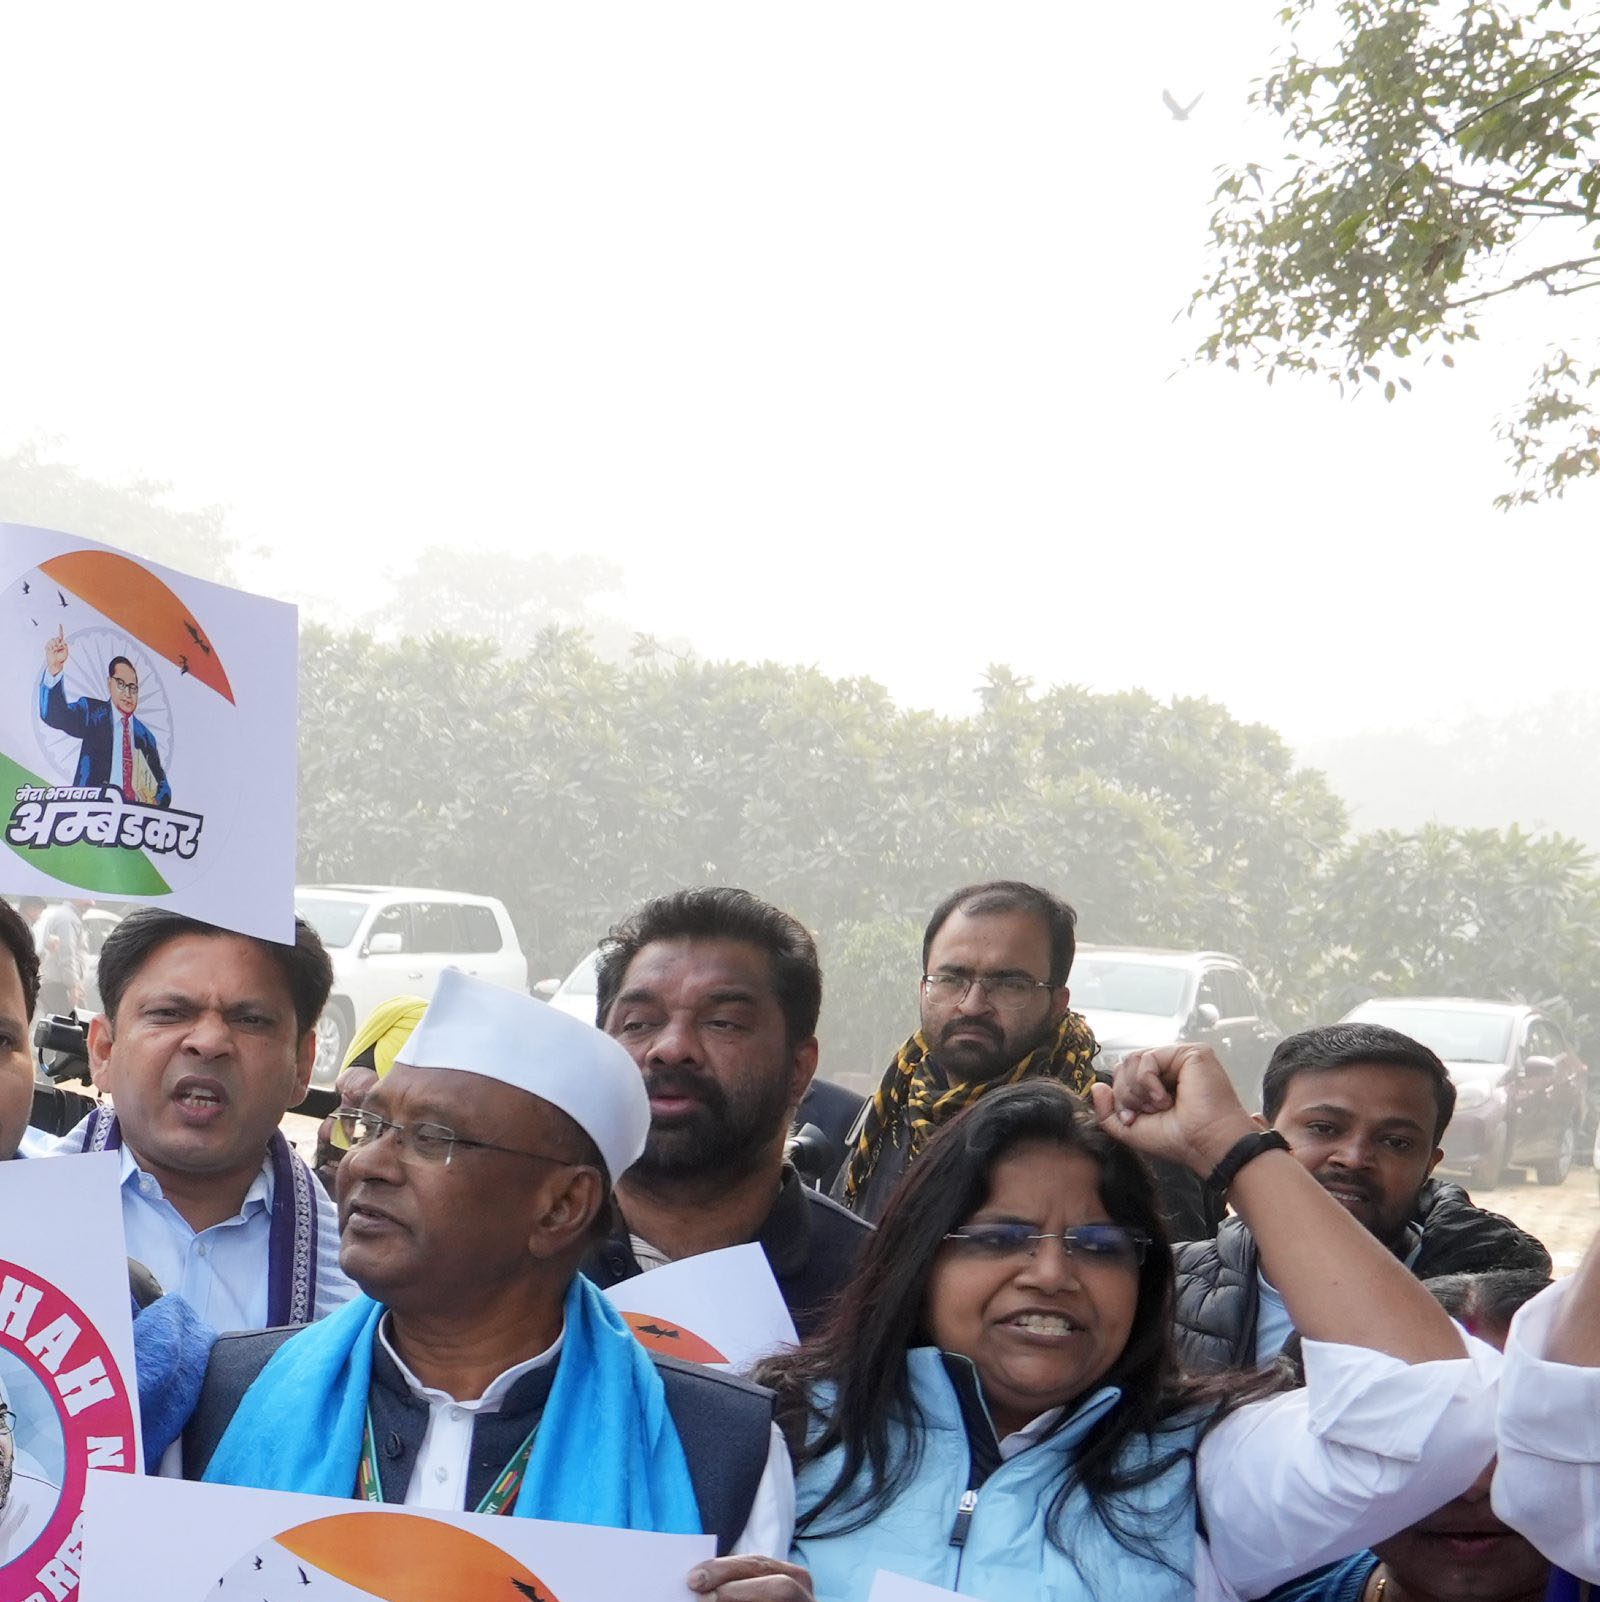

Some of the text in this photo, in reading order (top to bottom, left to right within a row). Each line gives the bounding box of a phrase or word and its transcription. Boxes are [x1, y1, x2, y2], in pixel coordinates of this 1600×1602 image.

[15, 784, 101, 801] मेरा भगवान
[8, 788, 201, 857] अम्बेडकर
